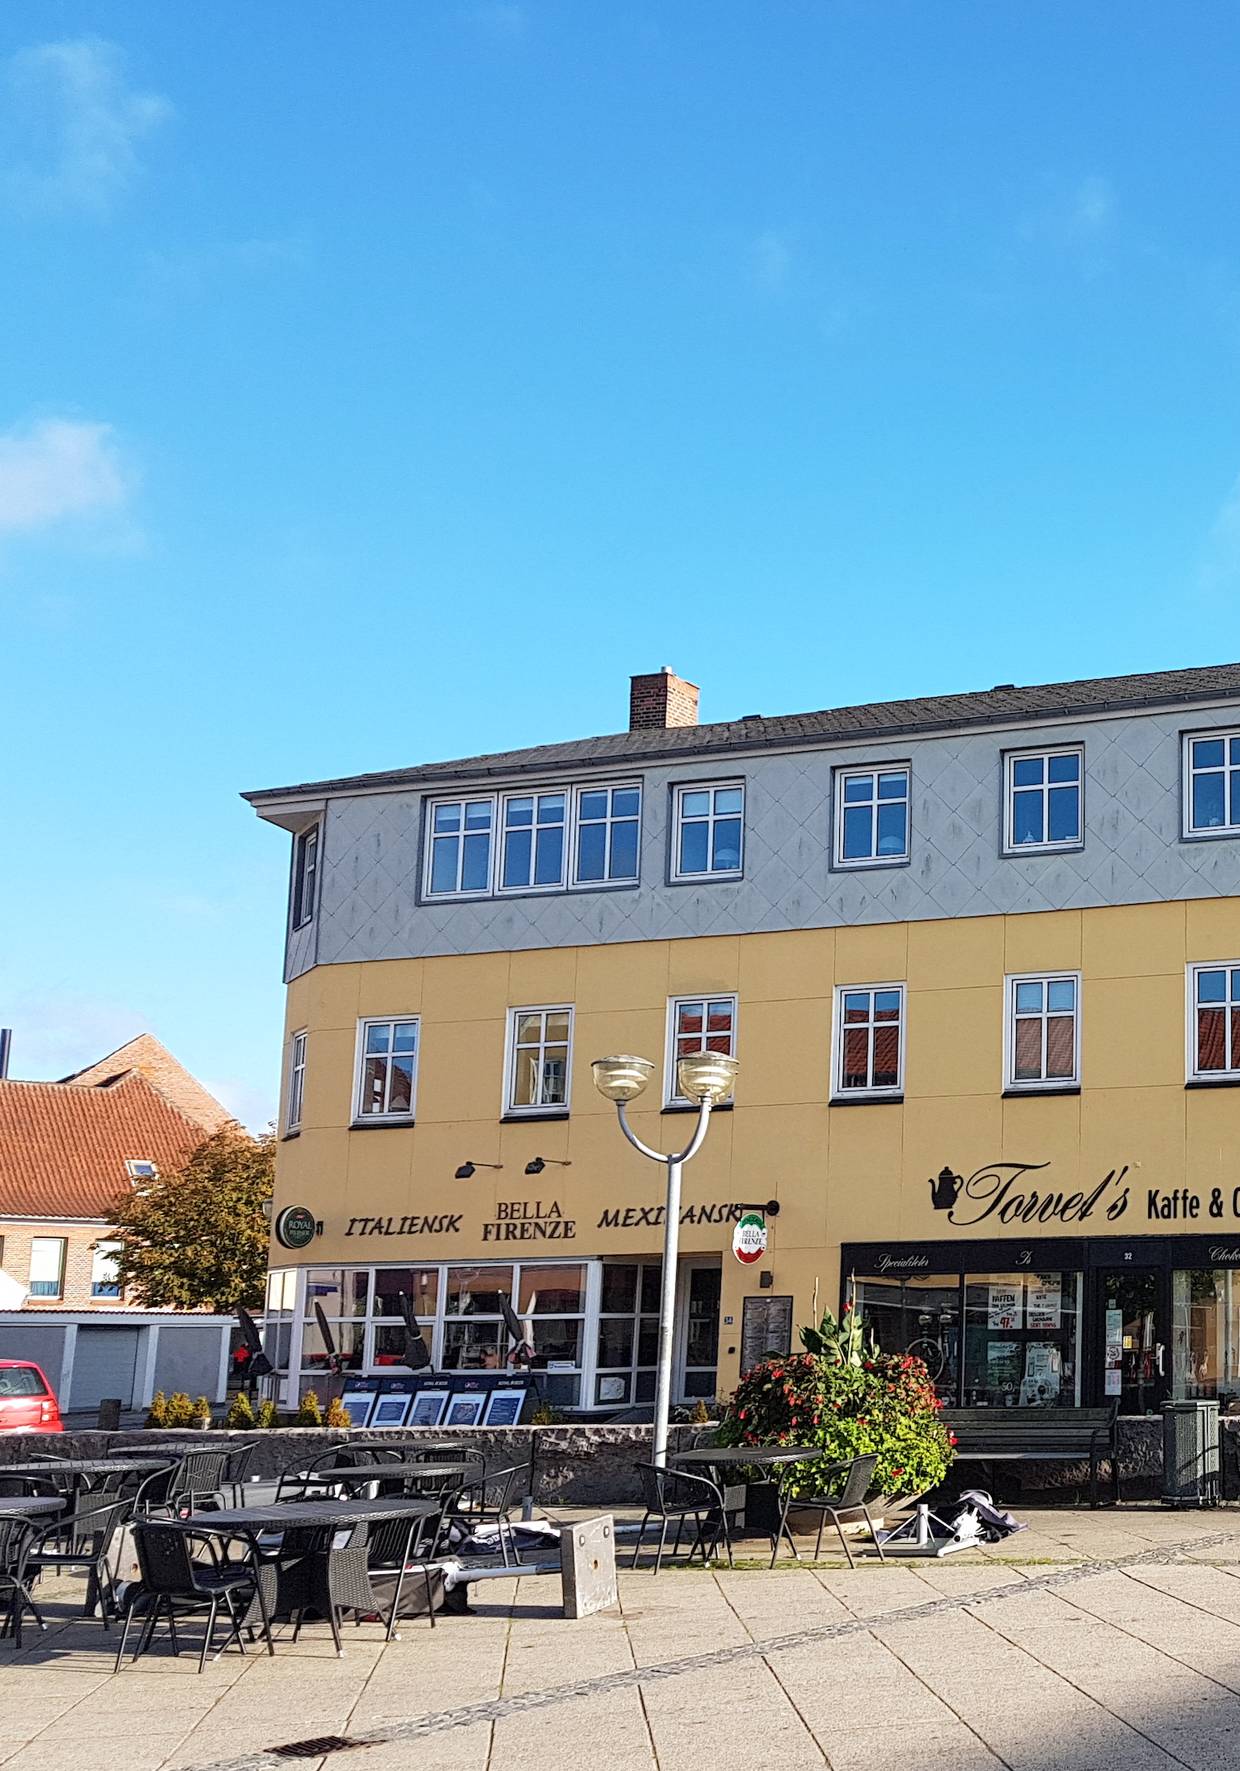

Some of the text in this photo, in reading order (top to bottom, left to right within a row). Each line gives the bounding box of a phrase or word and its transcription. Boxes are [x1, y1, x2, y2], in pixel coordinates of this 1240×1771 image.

[496, 1201, 562, 1220] BELLA
[1147, 1188, 1201, 1219] Kaffe
[1208, 1188, 1225, 1218] &
[344, 1214, 463, 1237] ITALIENSK
[597, 1203, 741, 1228] MEXIANSK
[481, 1221, 577, 1241] FIRENZE
